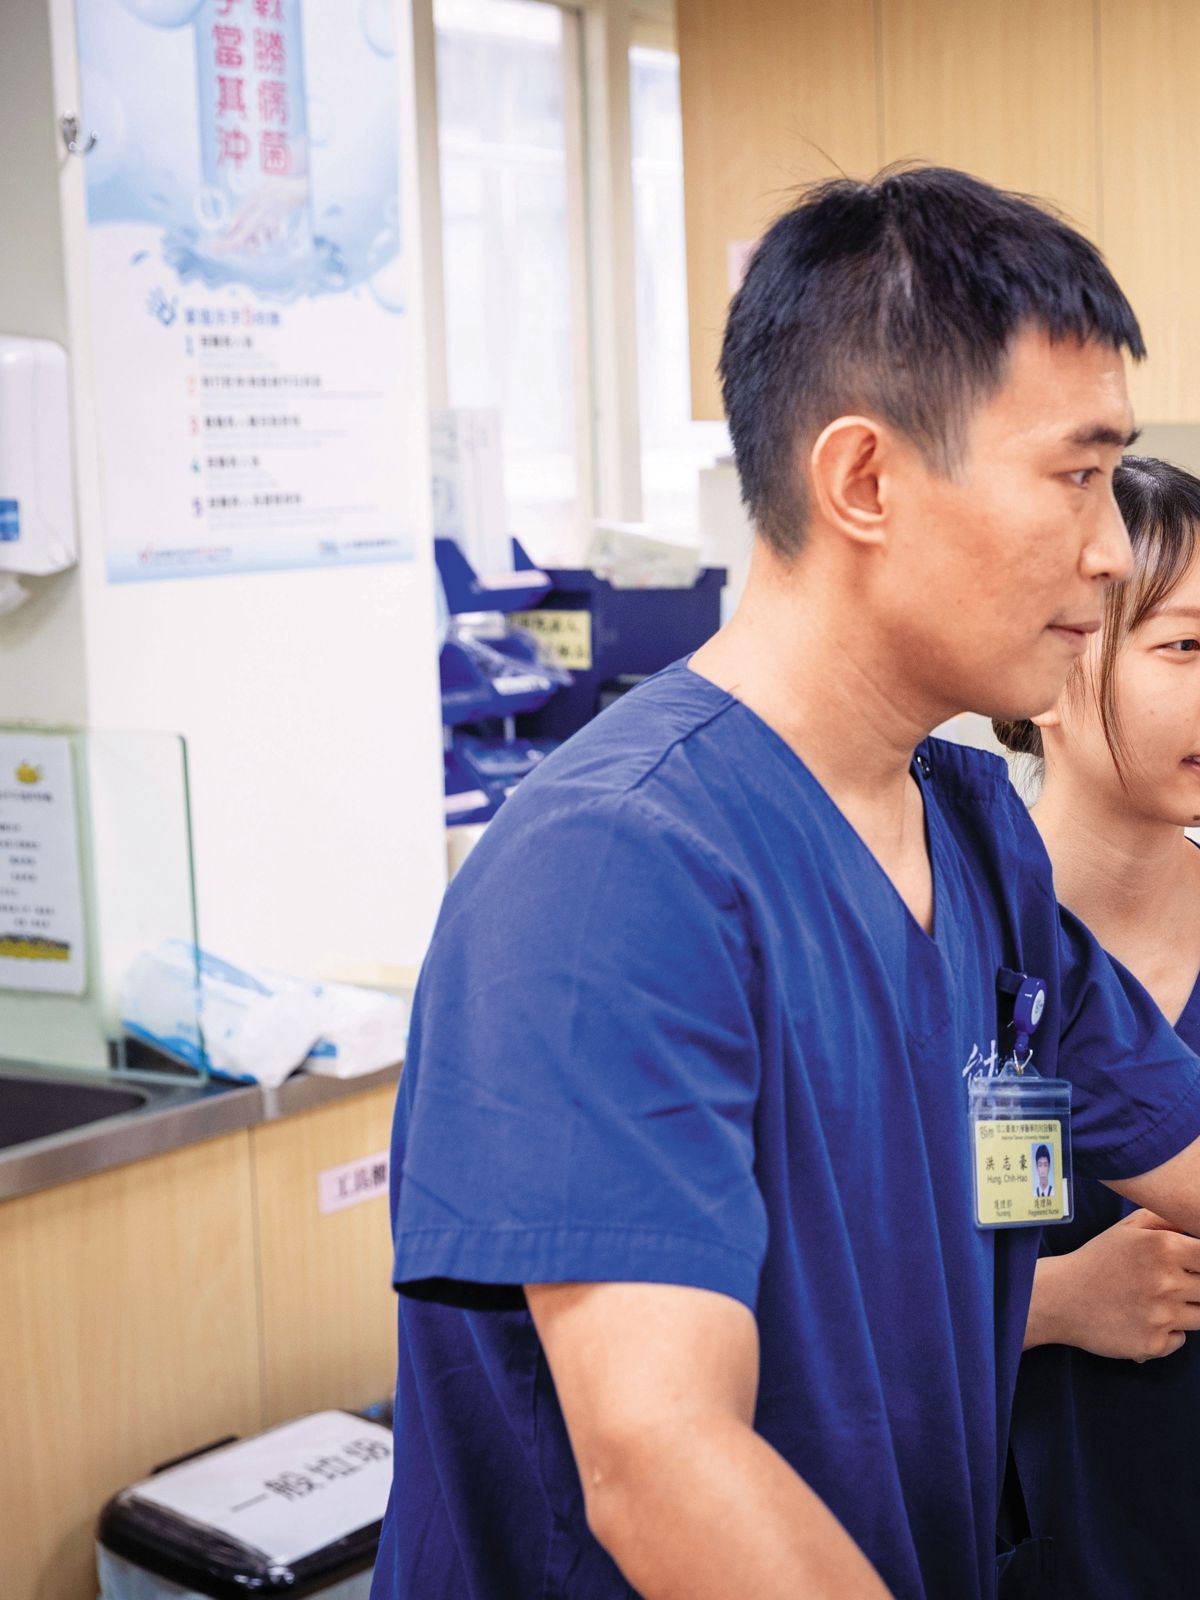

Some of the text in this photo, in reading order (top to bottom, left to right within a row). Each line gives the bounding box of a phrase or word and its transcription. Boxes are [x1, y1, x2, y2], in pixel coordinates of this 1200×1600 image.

[986, 1155, 1028, 1171] 洪志豪
[230, 1438, 391, 1513] 一般垃圾
